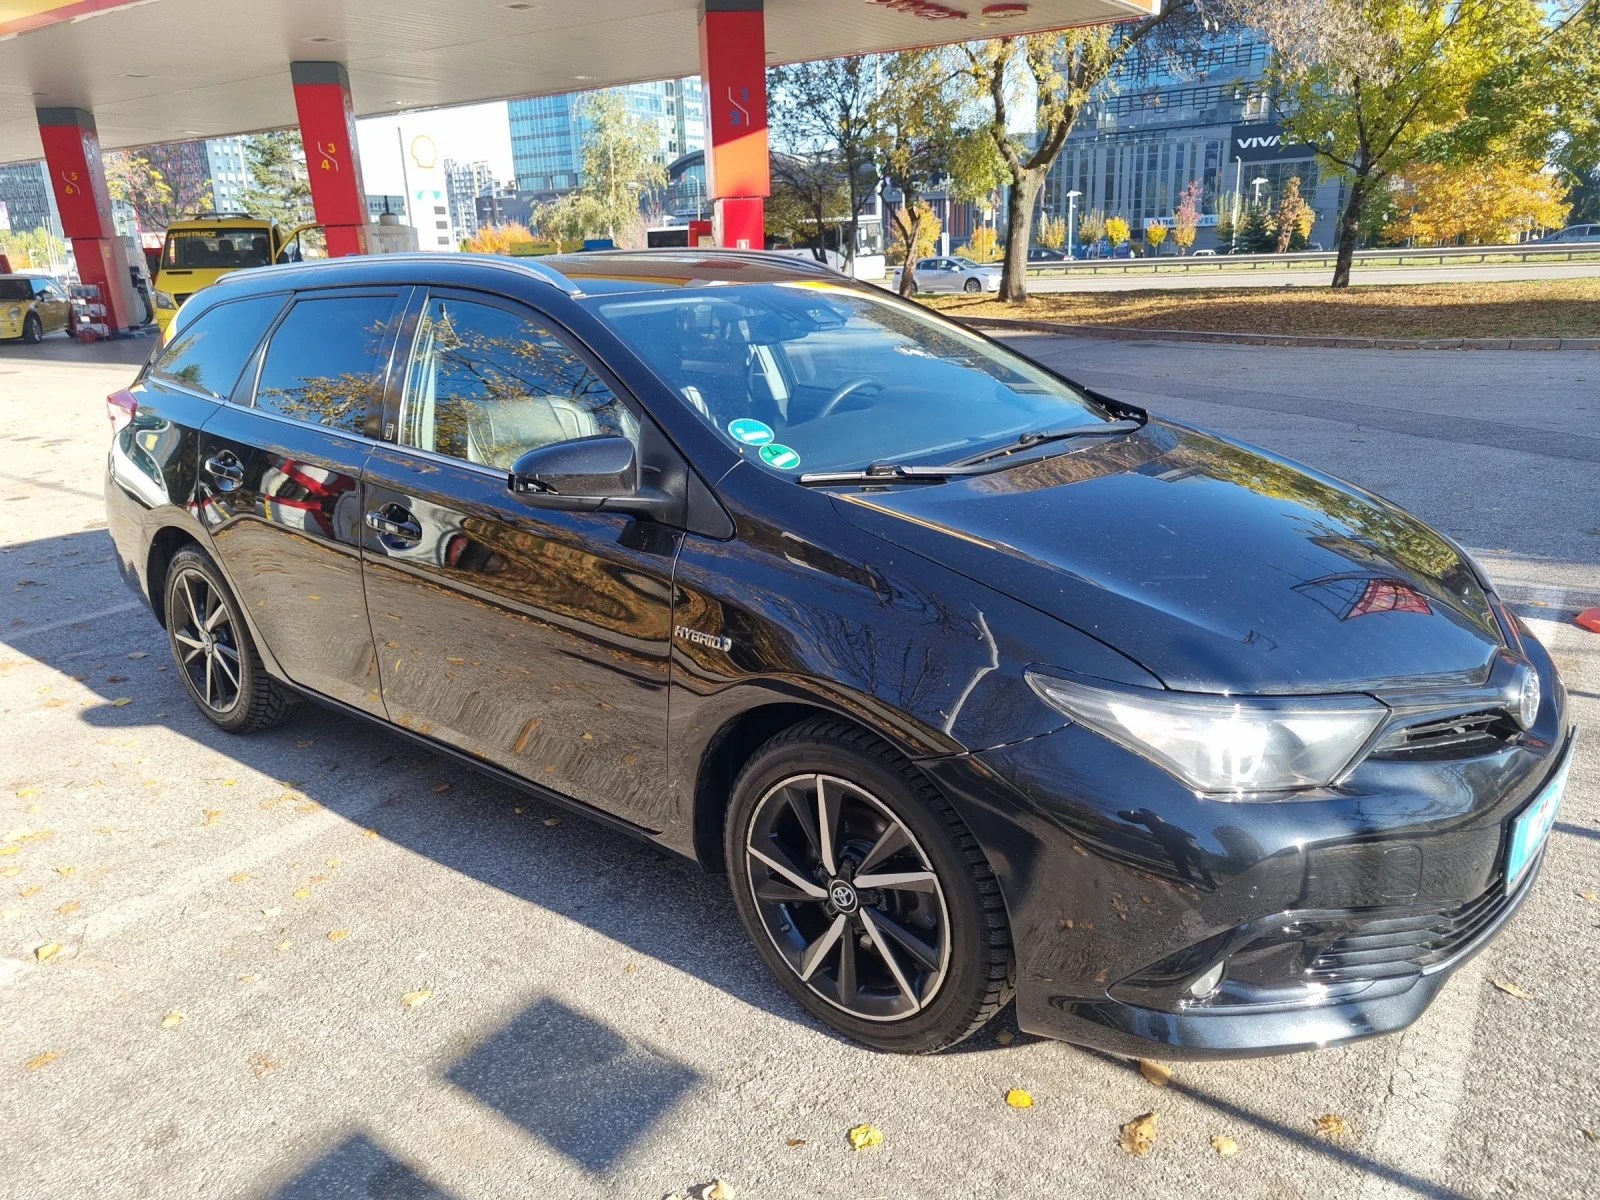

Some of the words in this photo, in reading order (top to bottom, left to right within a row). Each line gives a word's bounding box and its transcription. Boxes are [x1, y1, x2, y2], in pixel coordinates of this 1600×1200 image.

[741, 87, 749, 102] 1
[730, 109, 741, 125] 2
[327, 142, 336, 154] 3
[321, 159, 331, 171] 4
[71, 172, 78, 181] 5
[65, 185, 74, 195] 6
[168, 231, 217, 239] ASSISTANCE
[766, 446, 782, 457] 4
[674, 625, 723, 651] HYBRID
